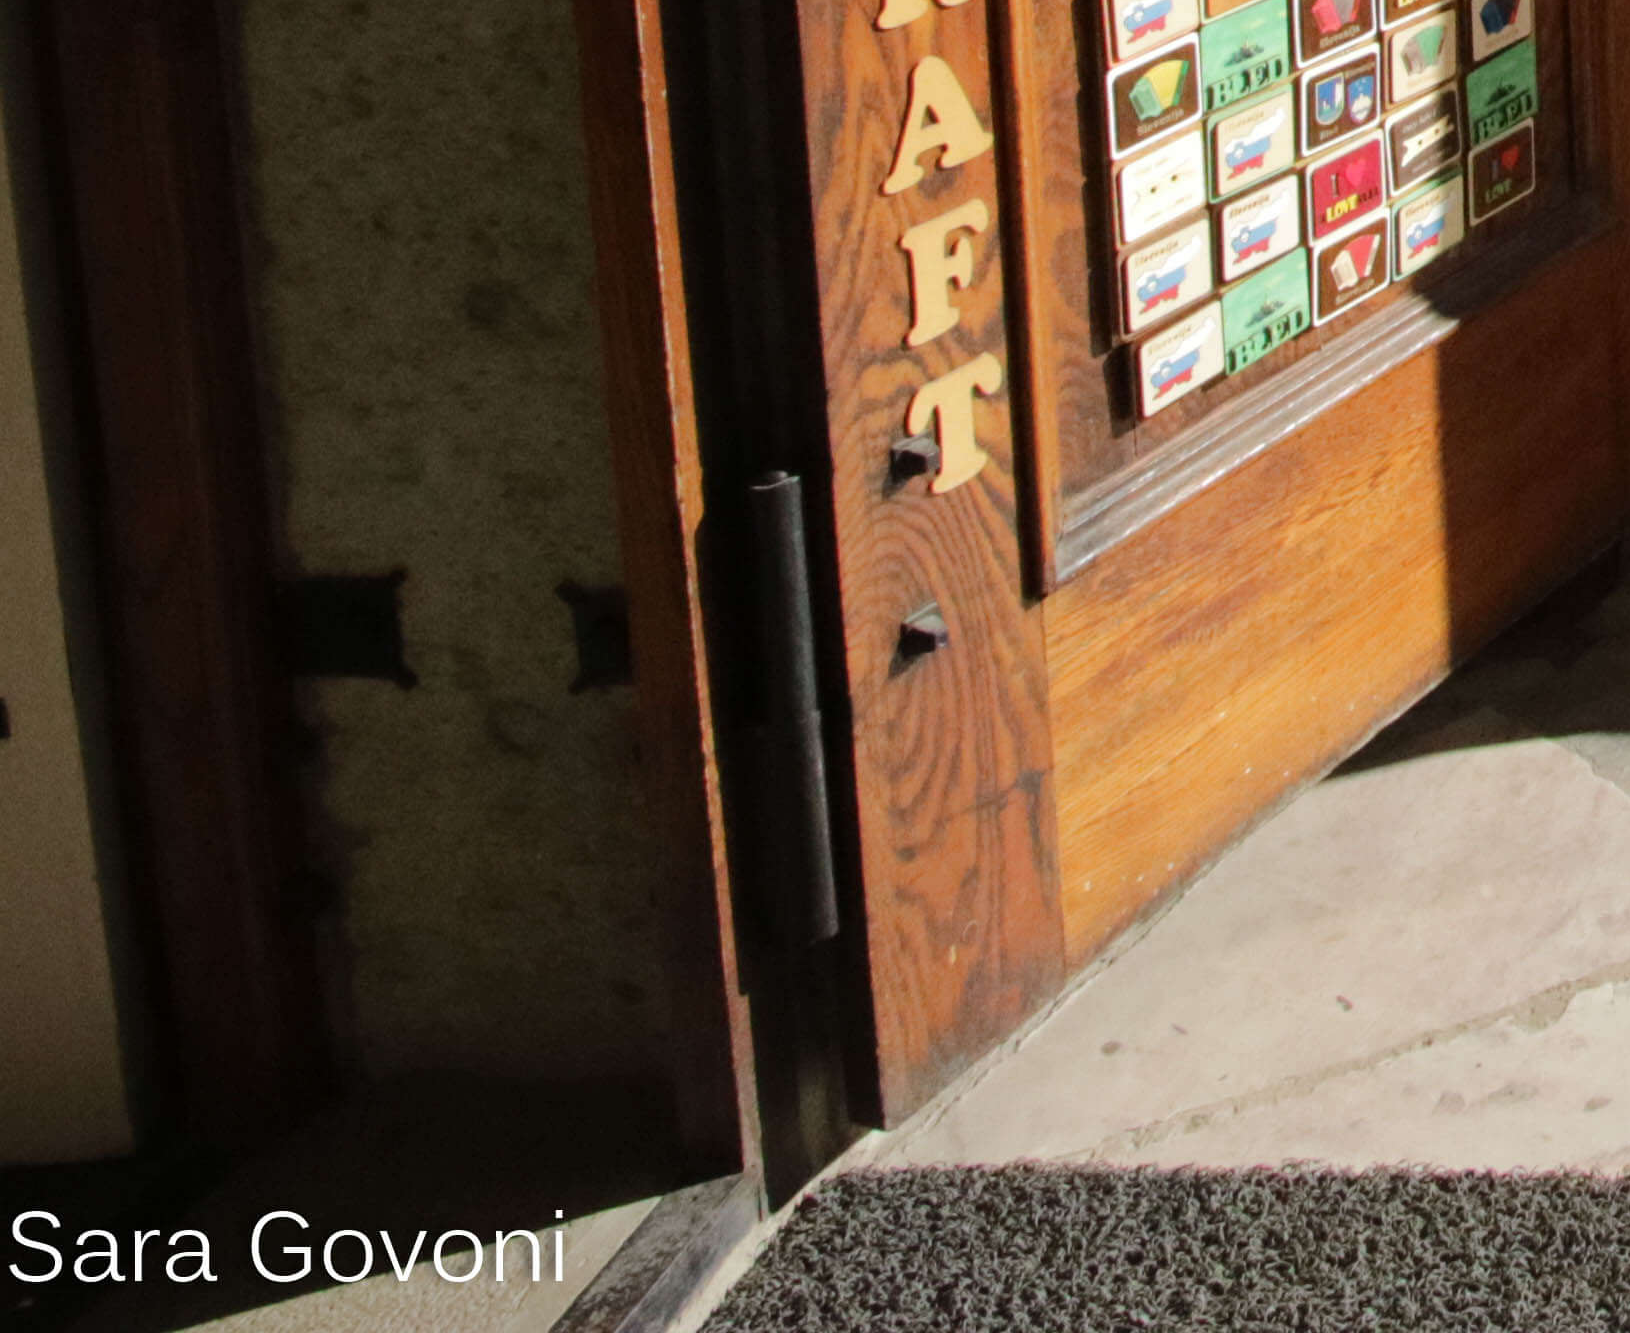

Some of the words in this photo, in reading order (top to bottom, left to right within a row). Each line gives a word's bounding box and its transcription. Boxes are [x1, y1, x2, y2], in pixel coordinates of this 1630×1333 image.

[1206, 57, 1283, 111] BLED
[1137, 108, 1185, 136] Slovenija
[1228, 195, 1271, 218] Slovenija
[1228, 310, 1303, 373] BLED
